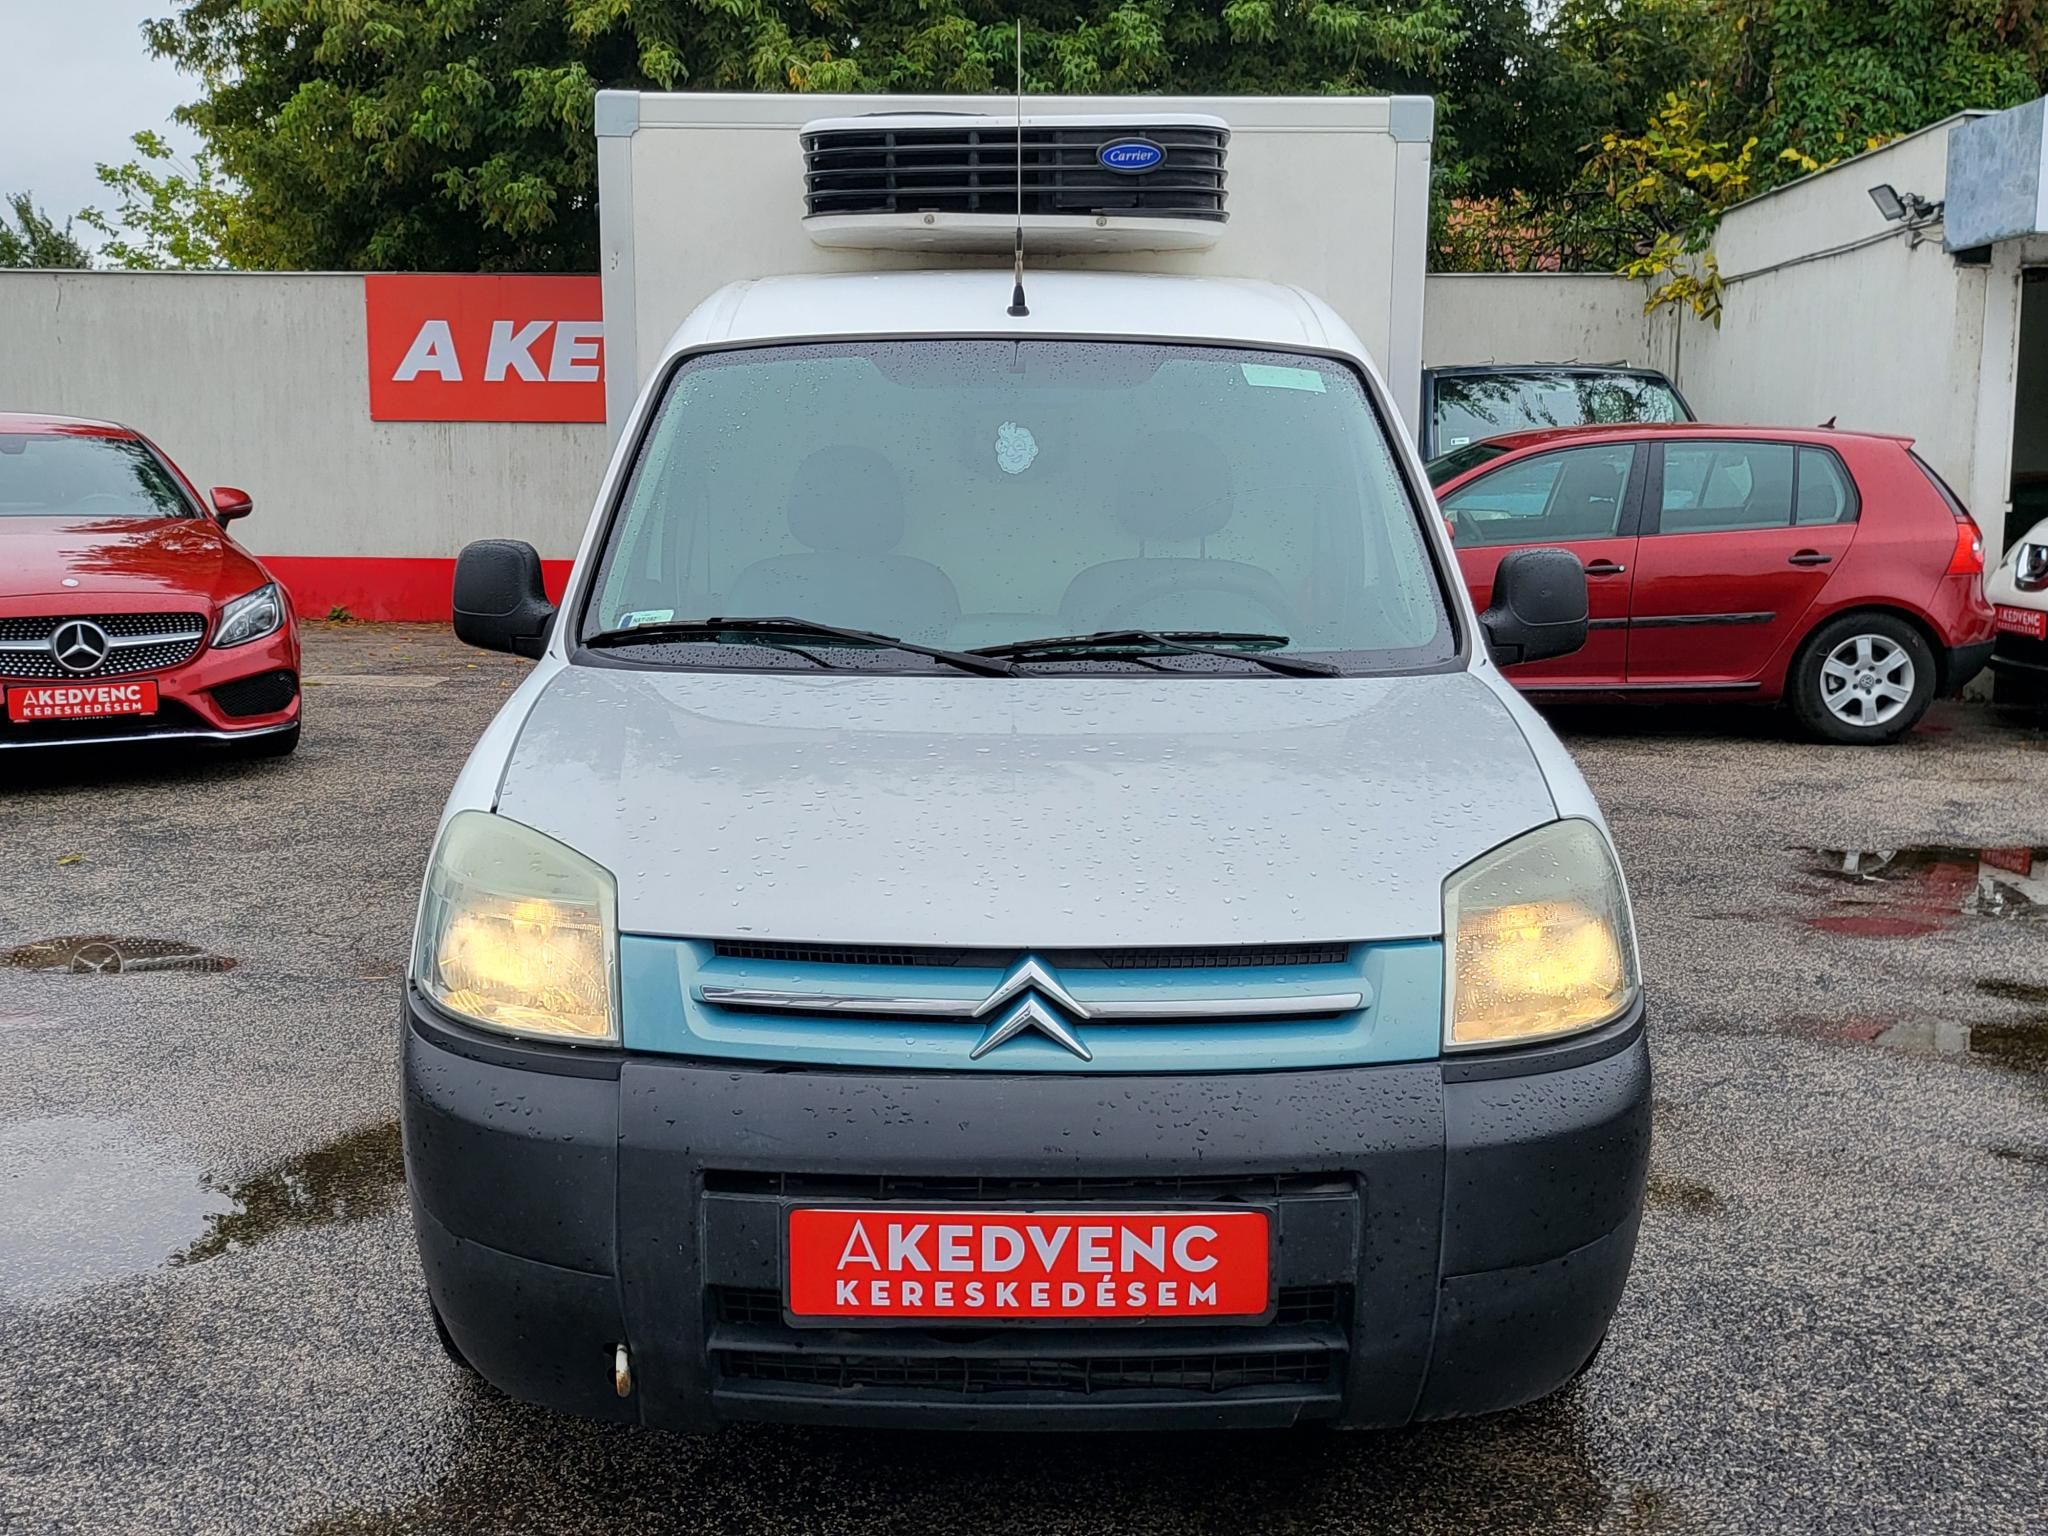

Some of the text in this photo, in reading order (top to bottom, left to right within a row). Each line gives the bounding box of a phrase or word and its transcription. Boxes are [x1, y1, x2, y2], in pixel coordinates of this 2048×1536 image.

[1110, 149, 1154, 162] Carrier
[391, 319, 464, 382] A
[23, 702, 142, 717] KERESKEDÉSEM
[836, 1275, 1217, 1307] KERESKEDÉSEM
